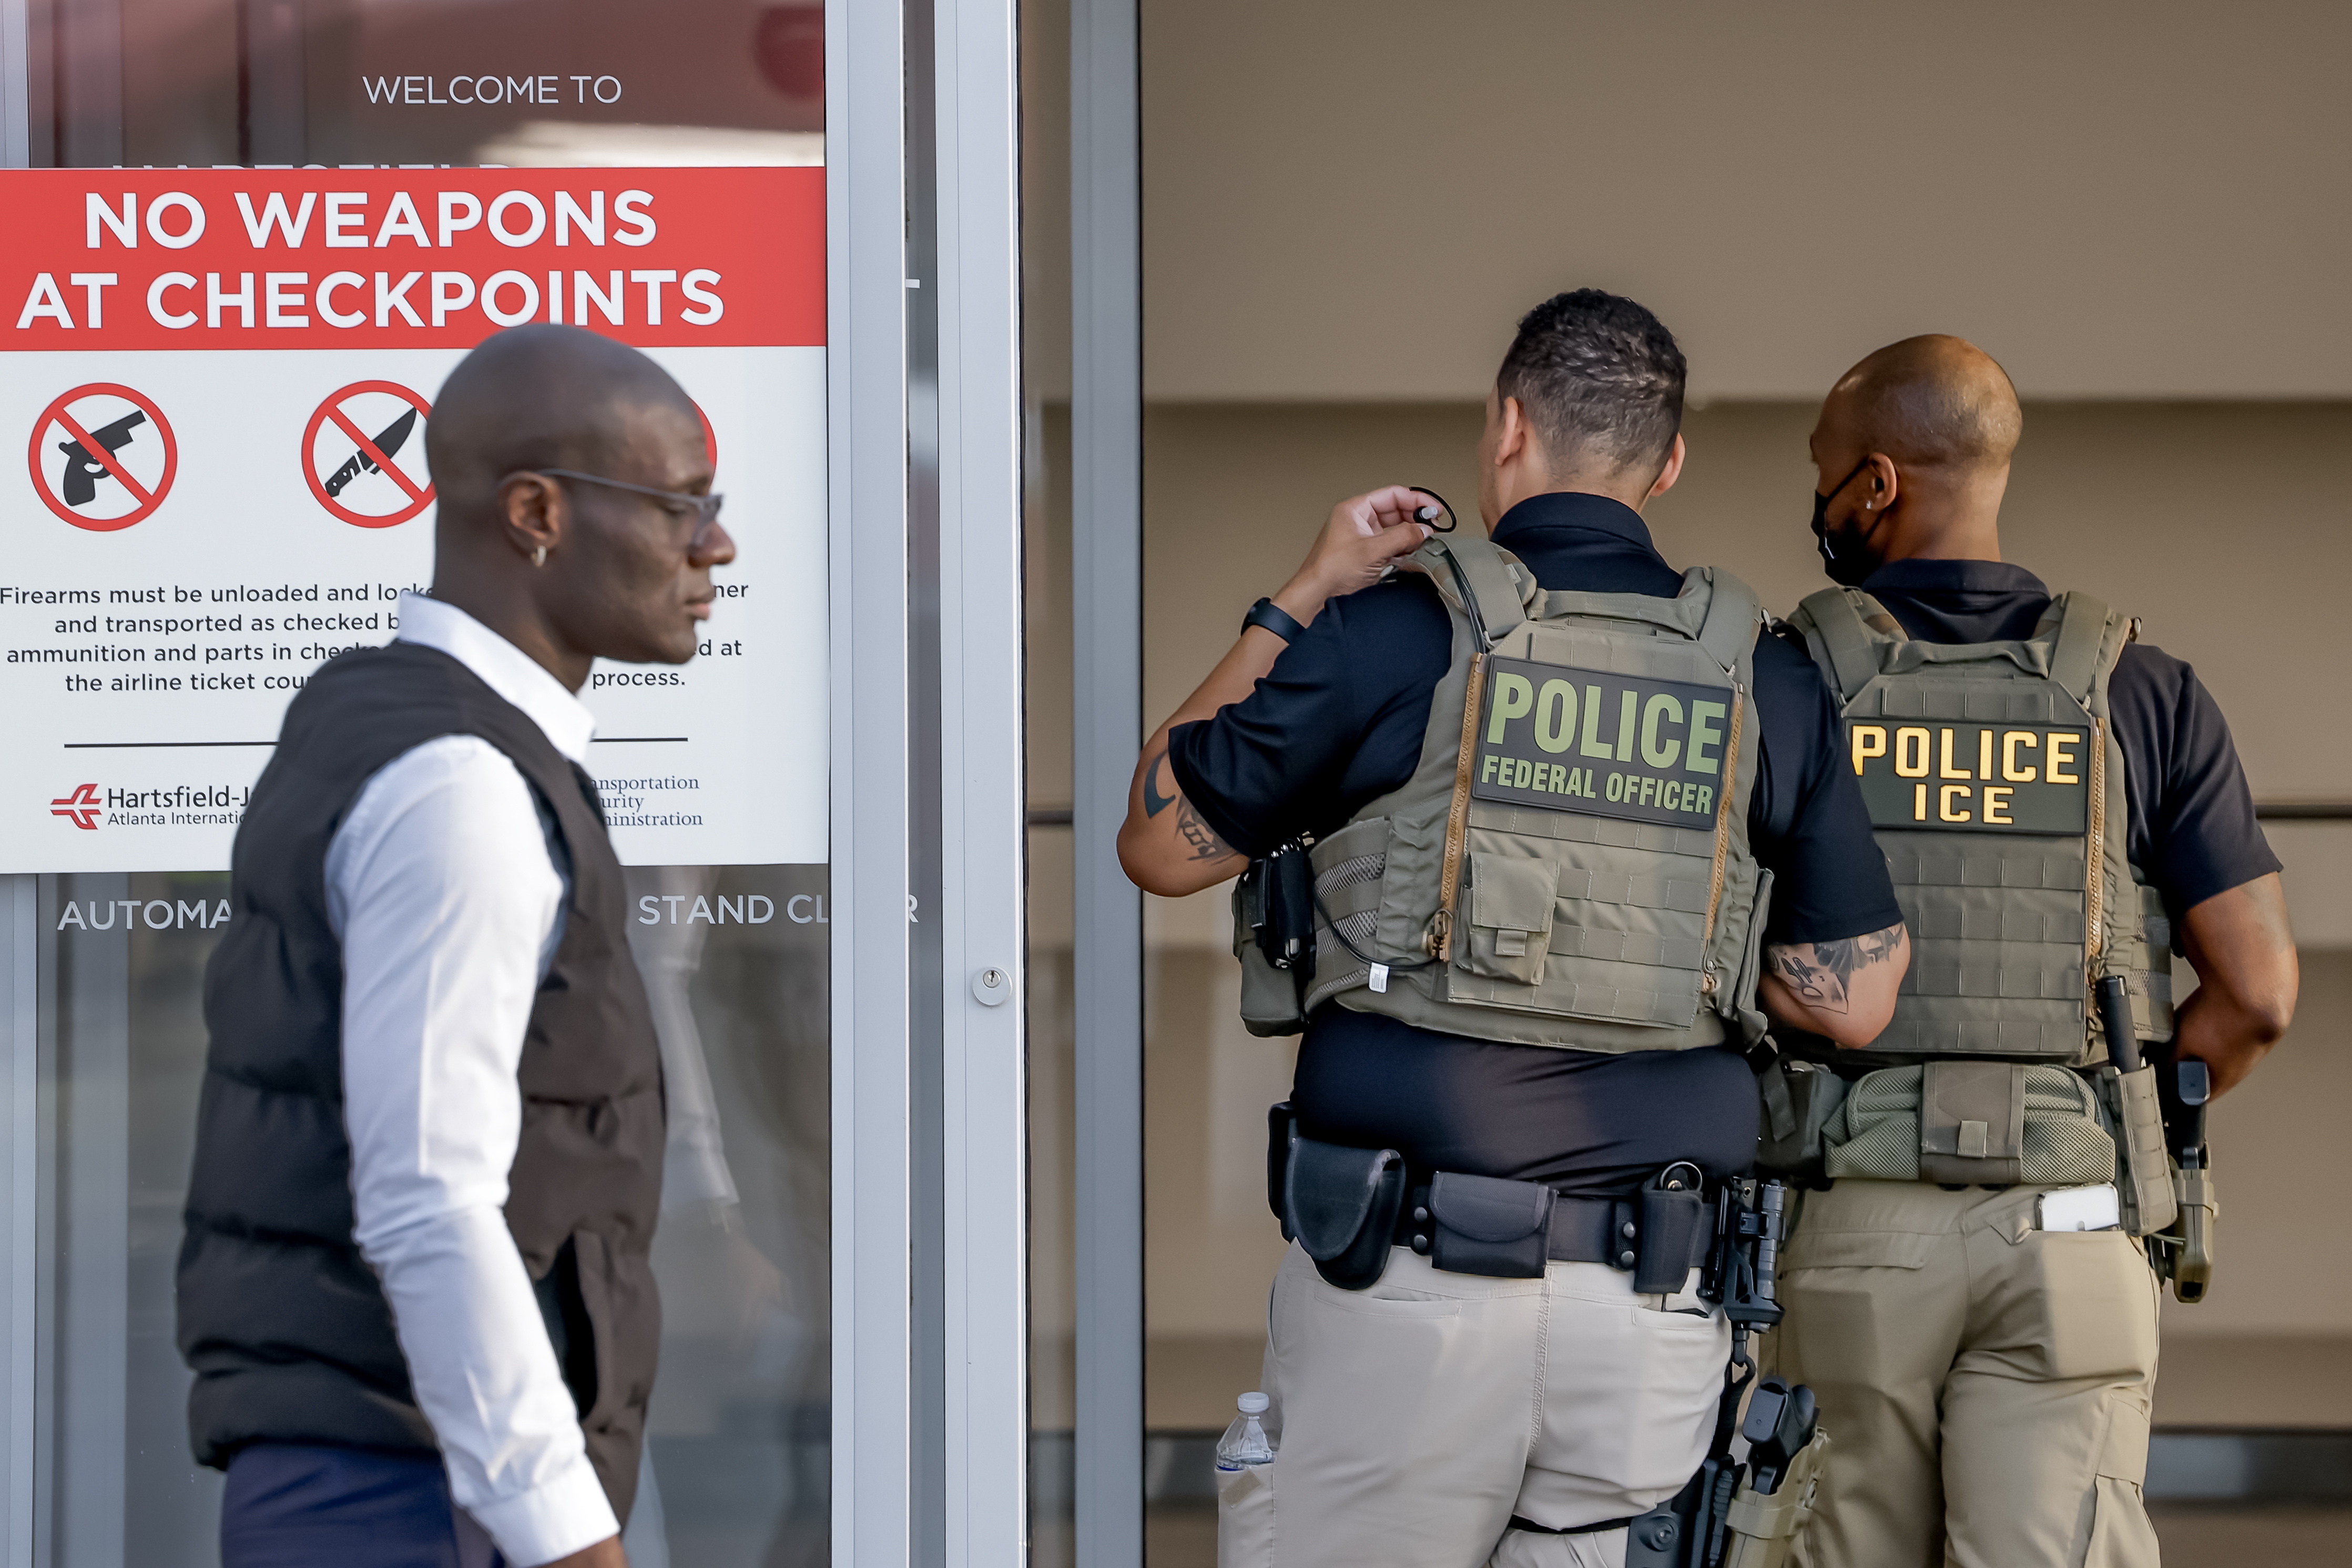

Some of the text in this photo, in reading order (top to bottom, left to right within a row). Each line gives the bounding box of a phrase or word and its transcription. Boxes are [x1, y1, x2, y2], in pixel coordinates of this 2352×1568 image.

[362, 75, 622, 104] WELCOME TO
[86, 189, 657, 249] NO WEAPONS
[16, 269, 724, 329] AT CHECKPOINTS
[0, 587, 100, 604] Firearms
[110, 586, 166, 603] must
[175, 585, 202, 603] be
[211, 584, 318, 603] unloaded
[327, 584, 369, 601] and
[55, 615, 97, 633] and
[105, 614, 242, 636] transported
[251, 618, 274, 631] as
[283, 613, 378, 631] checked
[7, 645, 145, 663] ammunition
[154, 644, 196, 661] and
[206, 644, 263, 665] parts
[272, 643, 291, 660] in
[721, 640, 742, 656] at
[65, 674, 103, 691] the
[111, 673, 182, 691] airline
[190, 673, 255, 690] ticket
[592, 670, 686, 690] process.
[1486, 671, 1726, 775] POLICE
[1851, 725, 2081, 784] POLICE
[1481, 754, 1714, 814] FEDERAL OFFICER
[107, 811, 166, 826] Atlanta
[1914, 782, 2014, 824] ICE
[637, 894, 775, 925] STAND
